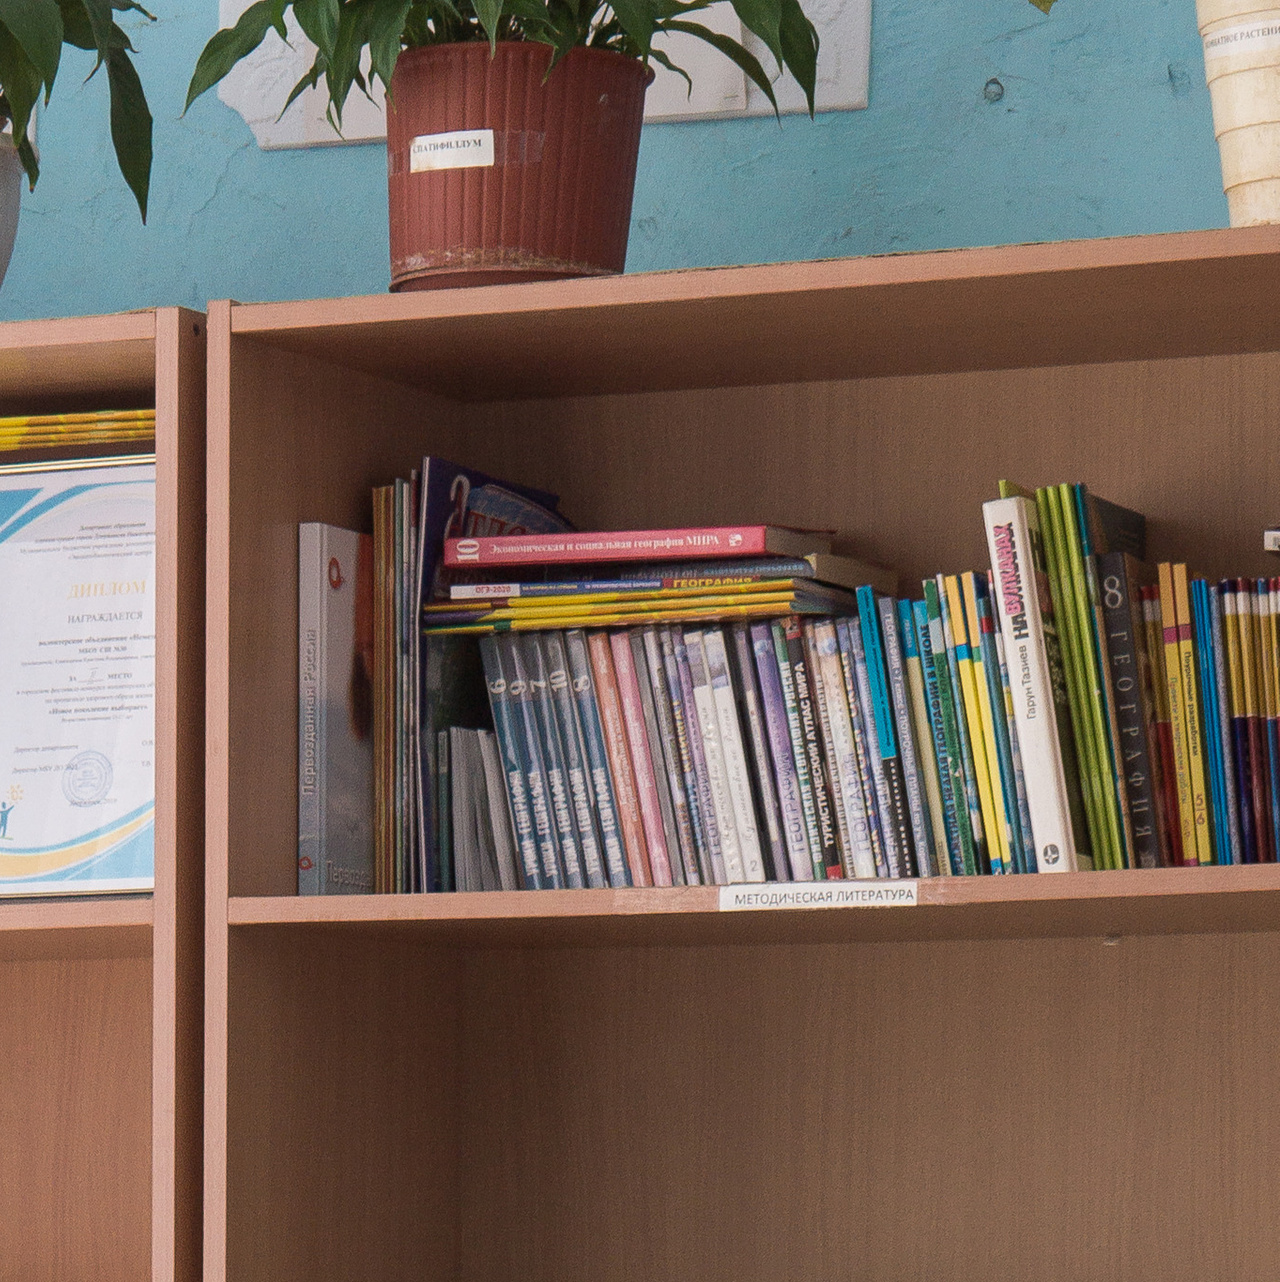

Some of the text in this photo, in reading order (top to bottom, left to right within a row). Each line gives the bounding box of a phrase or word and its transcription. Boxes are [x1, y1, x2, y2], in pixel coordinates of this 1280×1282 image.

[412, 138, 482, 154] СПАТИФИЛЛУМ
[456, 539, 480, 561] 10
[491, 543, 565, 554] Экономическая
[575, 541, 631, 551] социальная
[686, 535, 719, 546] МИРА
[67, 580, 147, 600] ДИПЛОМ
[475, 585, 511, 594] ОГЭ-2020
[673, 577, 752, 588] ГЕОГРАФИЯ
[992, 522, 1029, 640] НА ВУЛКАНАХ
[67, 611, 143, 624] НАГРАЖДАЕТСЯ
[883, 612, 901, 670] ГЕОГРАФИЯ
[920, 624, 936, 668] ШКОЛЕ
[489, 677, 508, 695] 6
[508, 678, 528, 696] 9
[529, 677, 547, 694] 7
[548, 668, 569, 692] 10
[572, 674, 591, 693] 8
[927, 670, 936, 679] В
[1016, 644, 1039, 721] Гарун Тазиев
[302, 630, 316, 795] Первозданная Россия
[928, 681, 948, 754] ГЕОГРАФИИ
[1101, 574, 1155, 838] 8 ГЕОГРАФИЯ
[1179, 651, 1203, 757] Поурочные разработки
[779, 661, 824, 864] ФИЗИЧЕСКАЯ ГЕОГРАФИЯ РОССИИ
[793, 662, 836, 848] ТУРИСТИЧЕСКИЙ АТЛАС МИРА
[899, 715, 916, 776] ПОУРОЧНЫЕ
[907, 776, 921, 812] ПЛАНЫ
[939, 756, 954, 801] НЕДЕЛЯ
[915, 840, 929, 878] Коринск
[735, 889, 914, 906] МЕТОДИЧЕСКАЯ ЛИТЕРАТУРА
